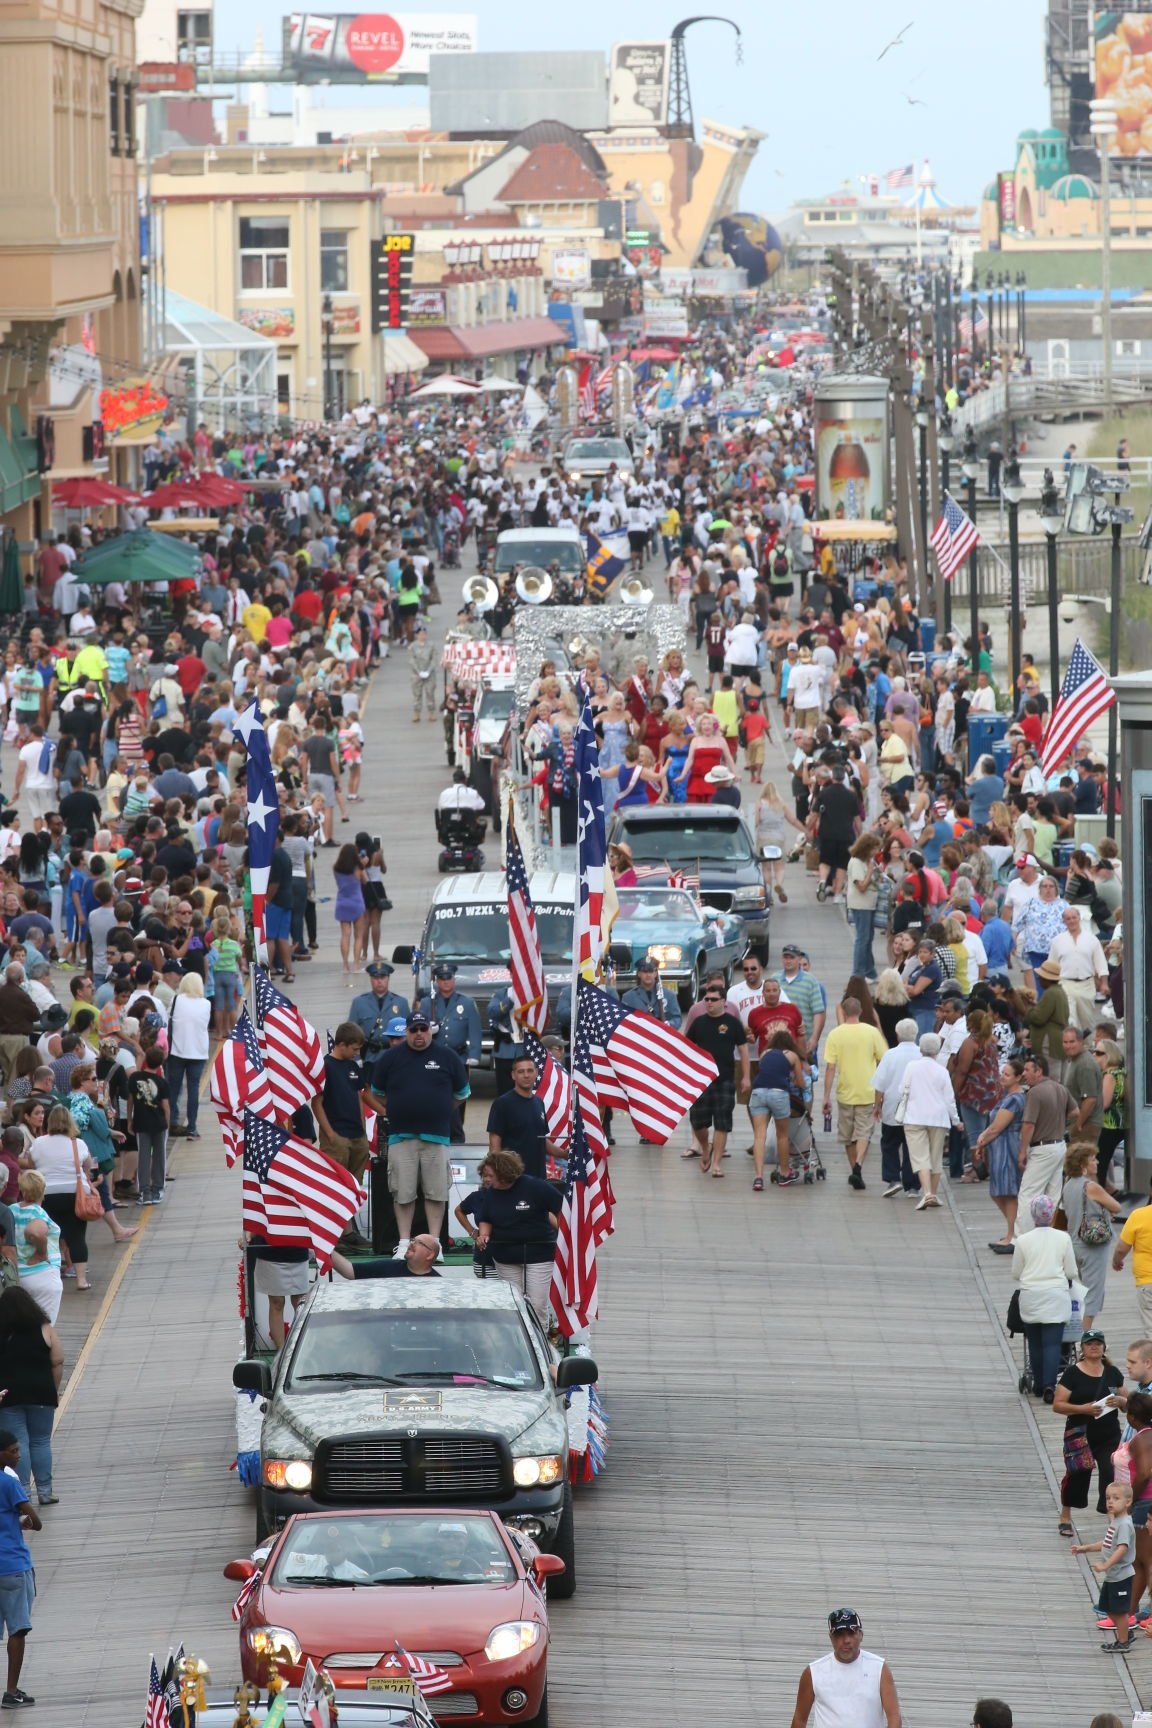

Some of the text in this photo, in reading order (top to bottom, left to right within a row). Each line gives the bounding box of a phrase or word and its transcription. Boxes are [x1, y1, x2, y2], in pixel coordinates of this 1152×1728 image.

[351, 31, 399, 45] REVEL
[410, 42, 433, 50] More
[435, 907, 463, 920] 100.7
[465, 904, 494, 916] WZXL
[534, 905, 552, 915] Roll
